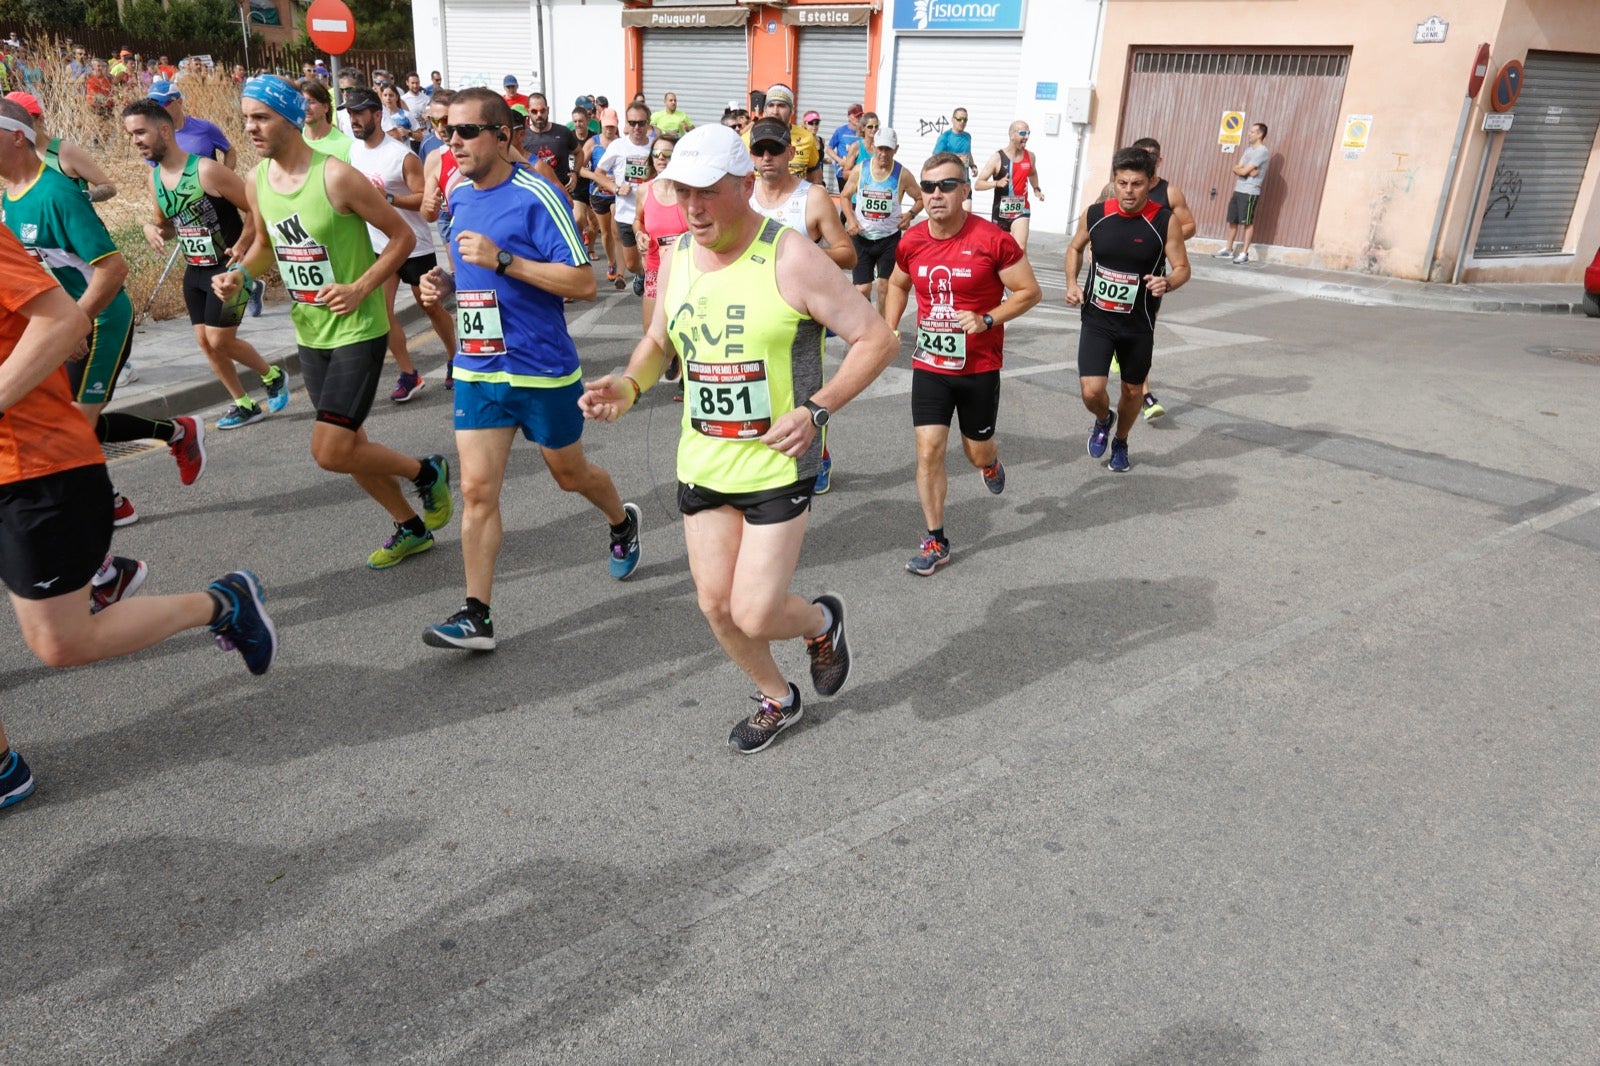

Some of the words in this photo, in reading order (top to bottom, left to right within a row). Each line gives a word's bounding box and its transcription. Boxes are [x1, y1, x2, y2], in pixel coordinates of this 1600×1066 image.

[652, 13, 706, 25] Peluqueria
[799, 11, 849, 22] Estetica
[929, 0, 1000, 22] fisiomar
[866, 199, 888, 211] 856
[1004, 203, 1021, 212] 358
[181, 239, 207, 253] 126
[289, 265, 324, 287] 166
[1098, 281, 1130, 301] 902
[463, 311, 485, 334] 84
[921, 333, 957, 353] 243
[712, 365, 732, 374] PREMIO
[740, 362, 760, 373] FONDO
[699, 386, 752, 416] 851
